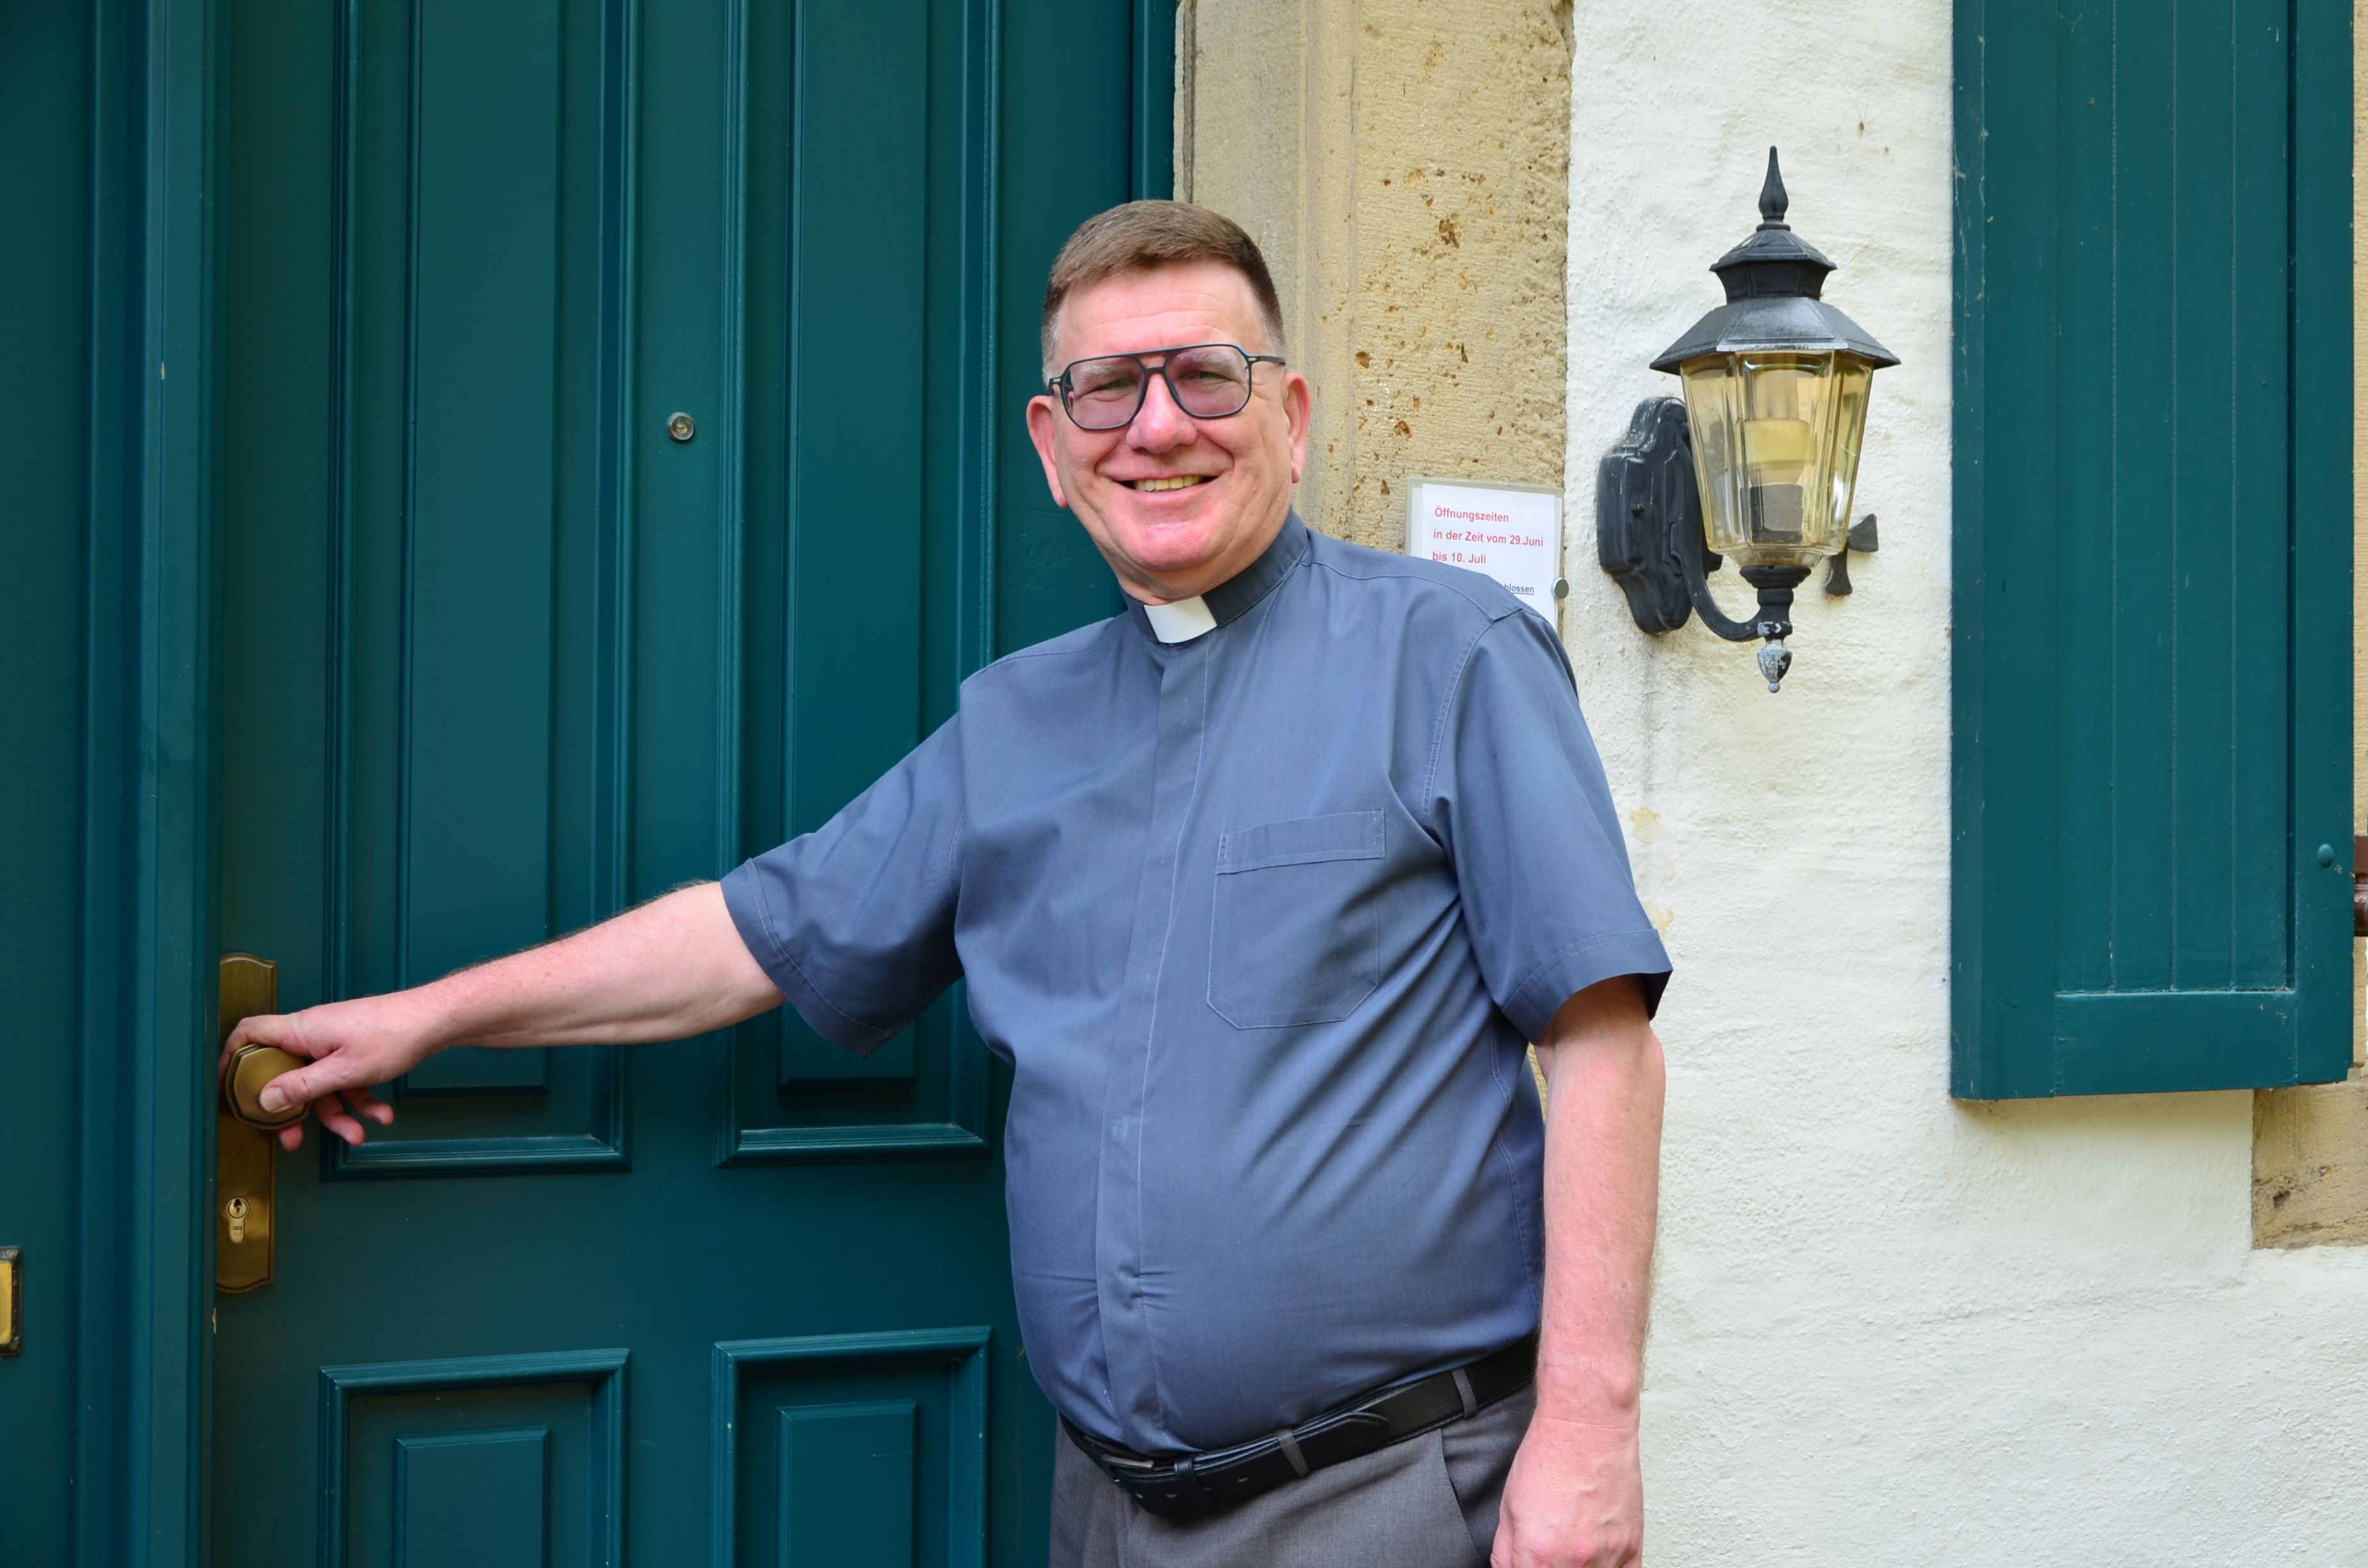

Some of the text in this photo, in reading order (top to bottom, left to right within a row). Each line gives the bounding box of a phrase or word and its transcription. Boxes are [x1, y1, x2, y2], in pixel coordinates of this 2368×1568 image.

[1435, 505, 1509, 522] Öffnungszeiten
[1433, 529, 1543, 546] in der Zeit vom 29.Juni
[1432, 551, 1486, 564] bis 10. Juli
[1504, 583, 1534, 593] hlossen
